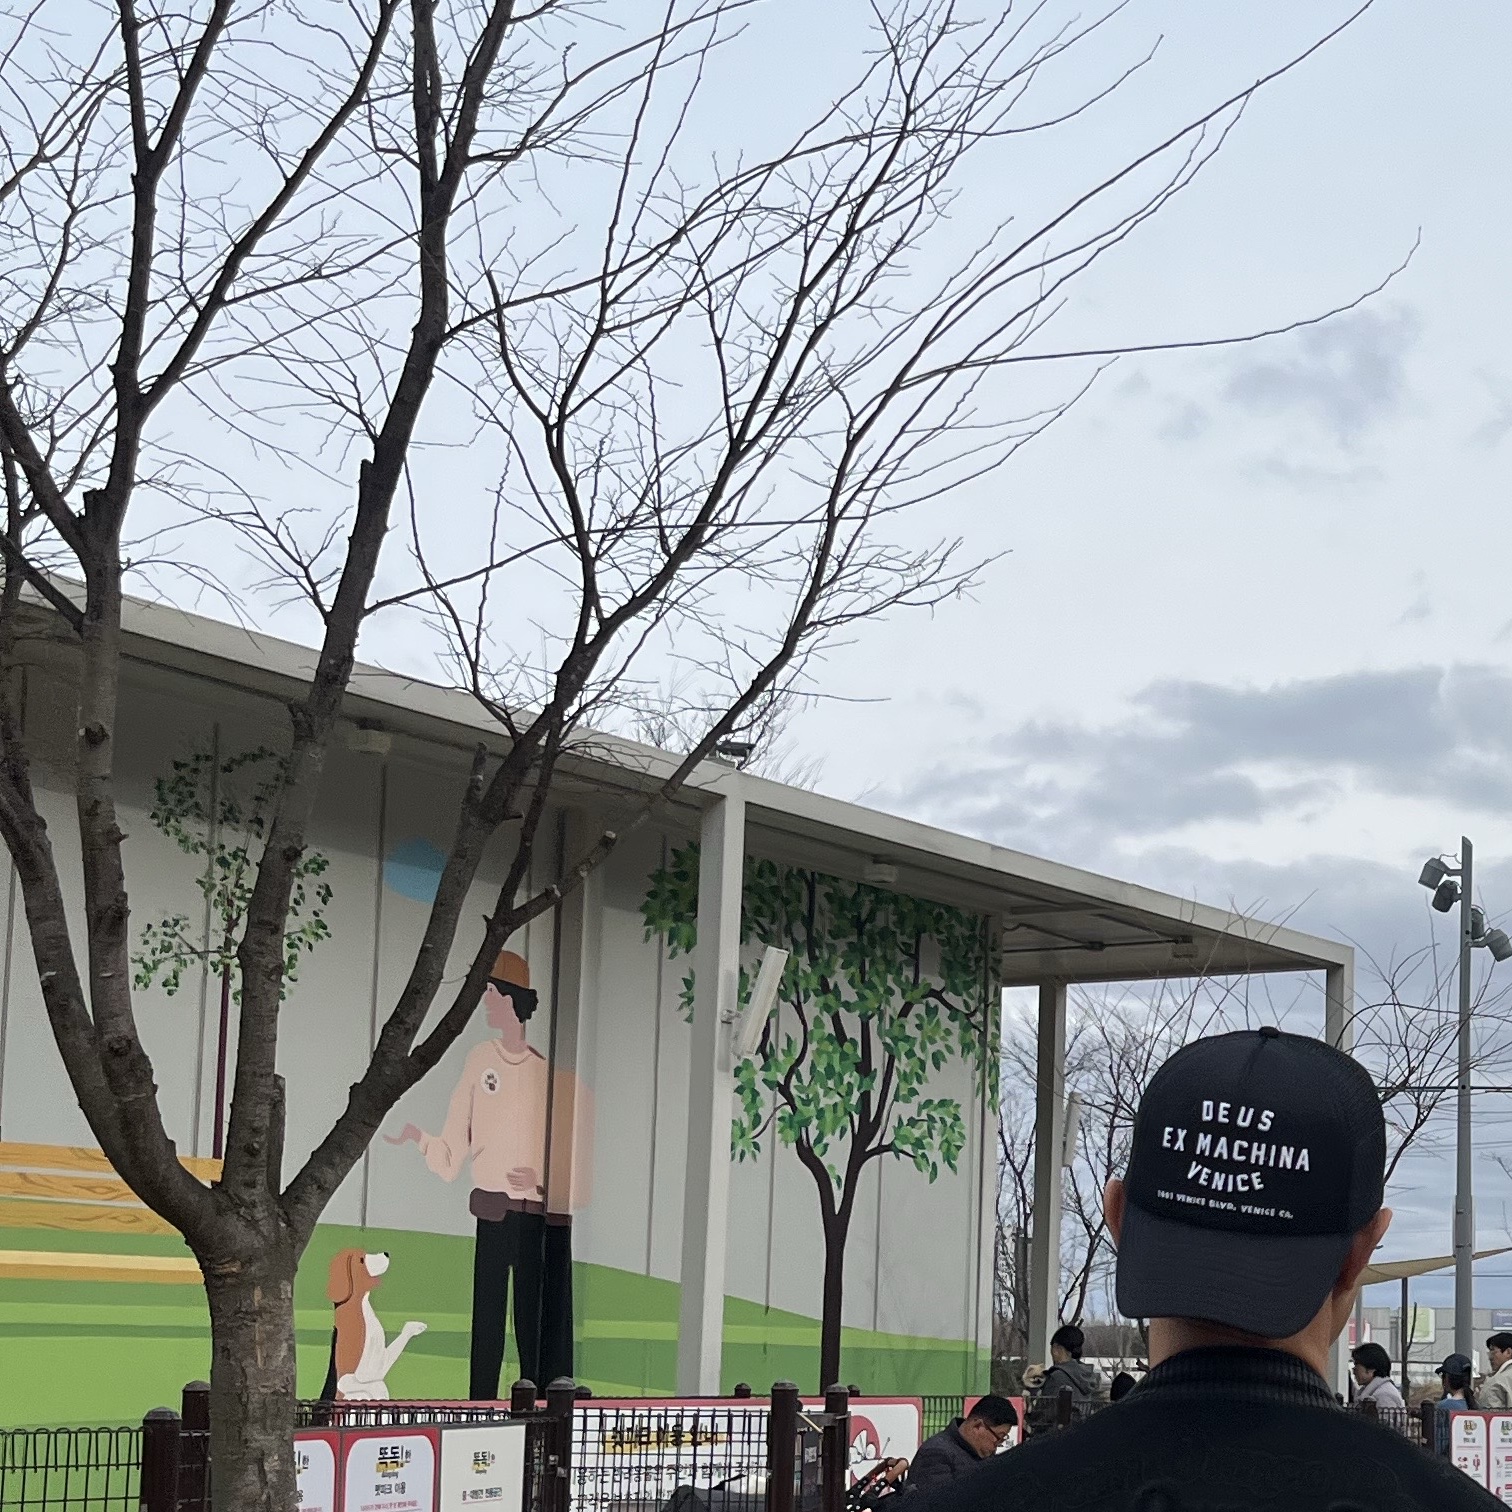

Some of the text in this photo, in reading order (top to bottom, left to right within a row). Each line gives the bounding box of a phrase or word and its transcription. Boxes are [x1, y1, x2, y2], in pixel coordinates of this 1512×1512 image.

[1201, 1099, 1276, 1132] DEUS
[1162, 1126, 1310, 1172] EX MACHINA
[1186, 1160, 1265, 1193] VENICE
[1176, 1193, 1206, 1206] VENICE
[1241, 1204, 1276, 1217] VENICE
